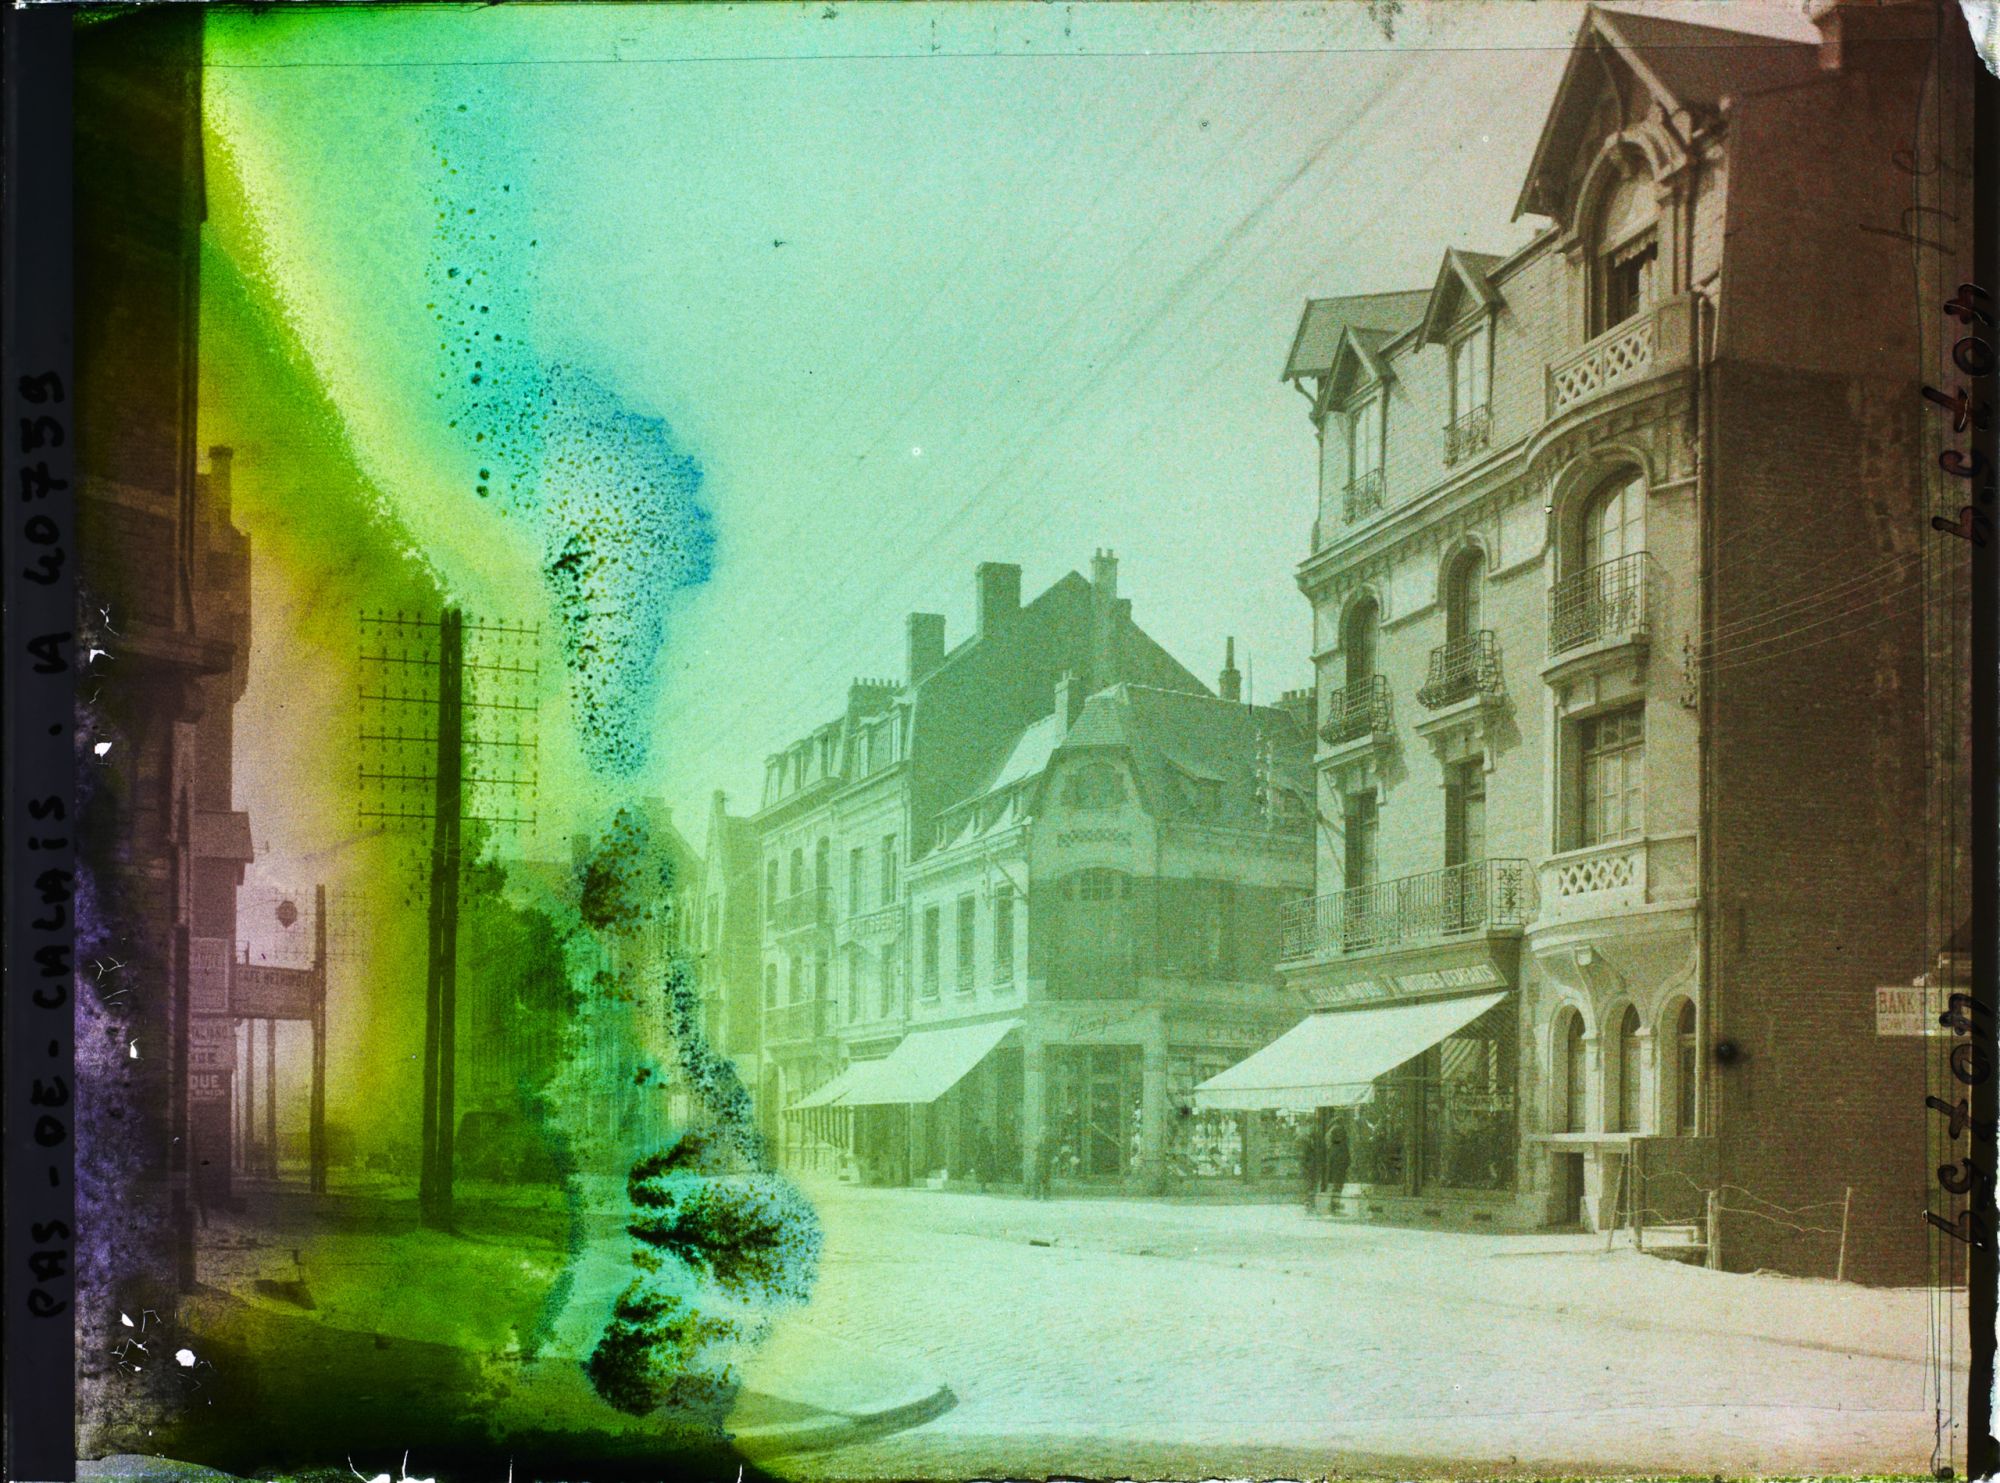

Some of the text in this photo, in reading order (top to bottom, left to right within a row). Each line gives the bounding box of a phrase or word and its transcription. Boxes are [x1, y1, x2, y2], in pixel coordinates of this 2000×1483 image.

[19, 371, 66, 584] 40759
[26, 632, 71, 672] A
[1878, 991, 1916, 1014] BANK
